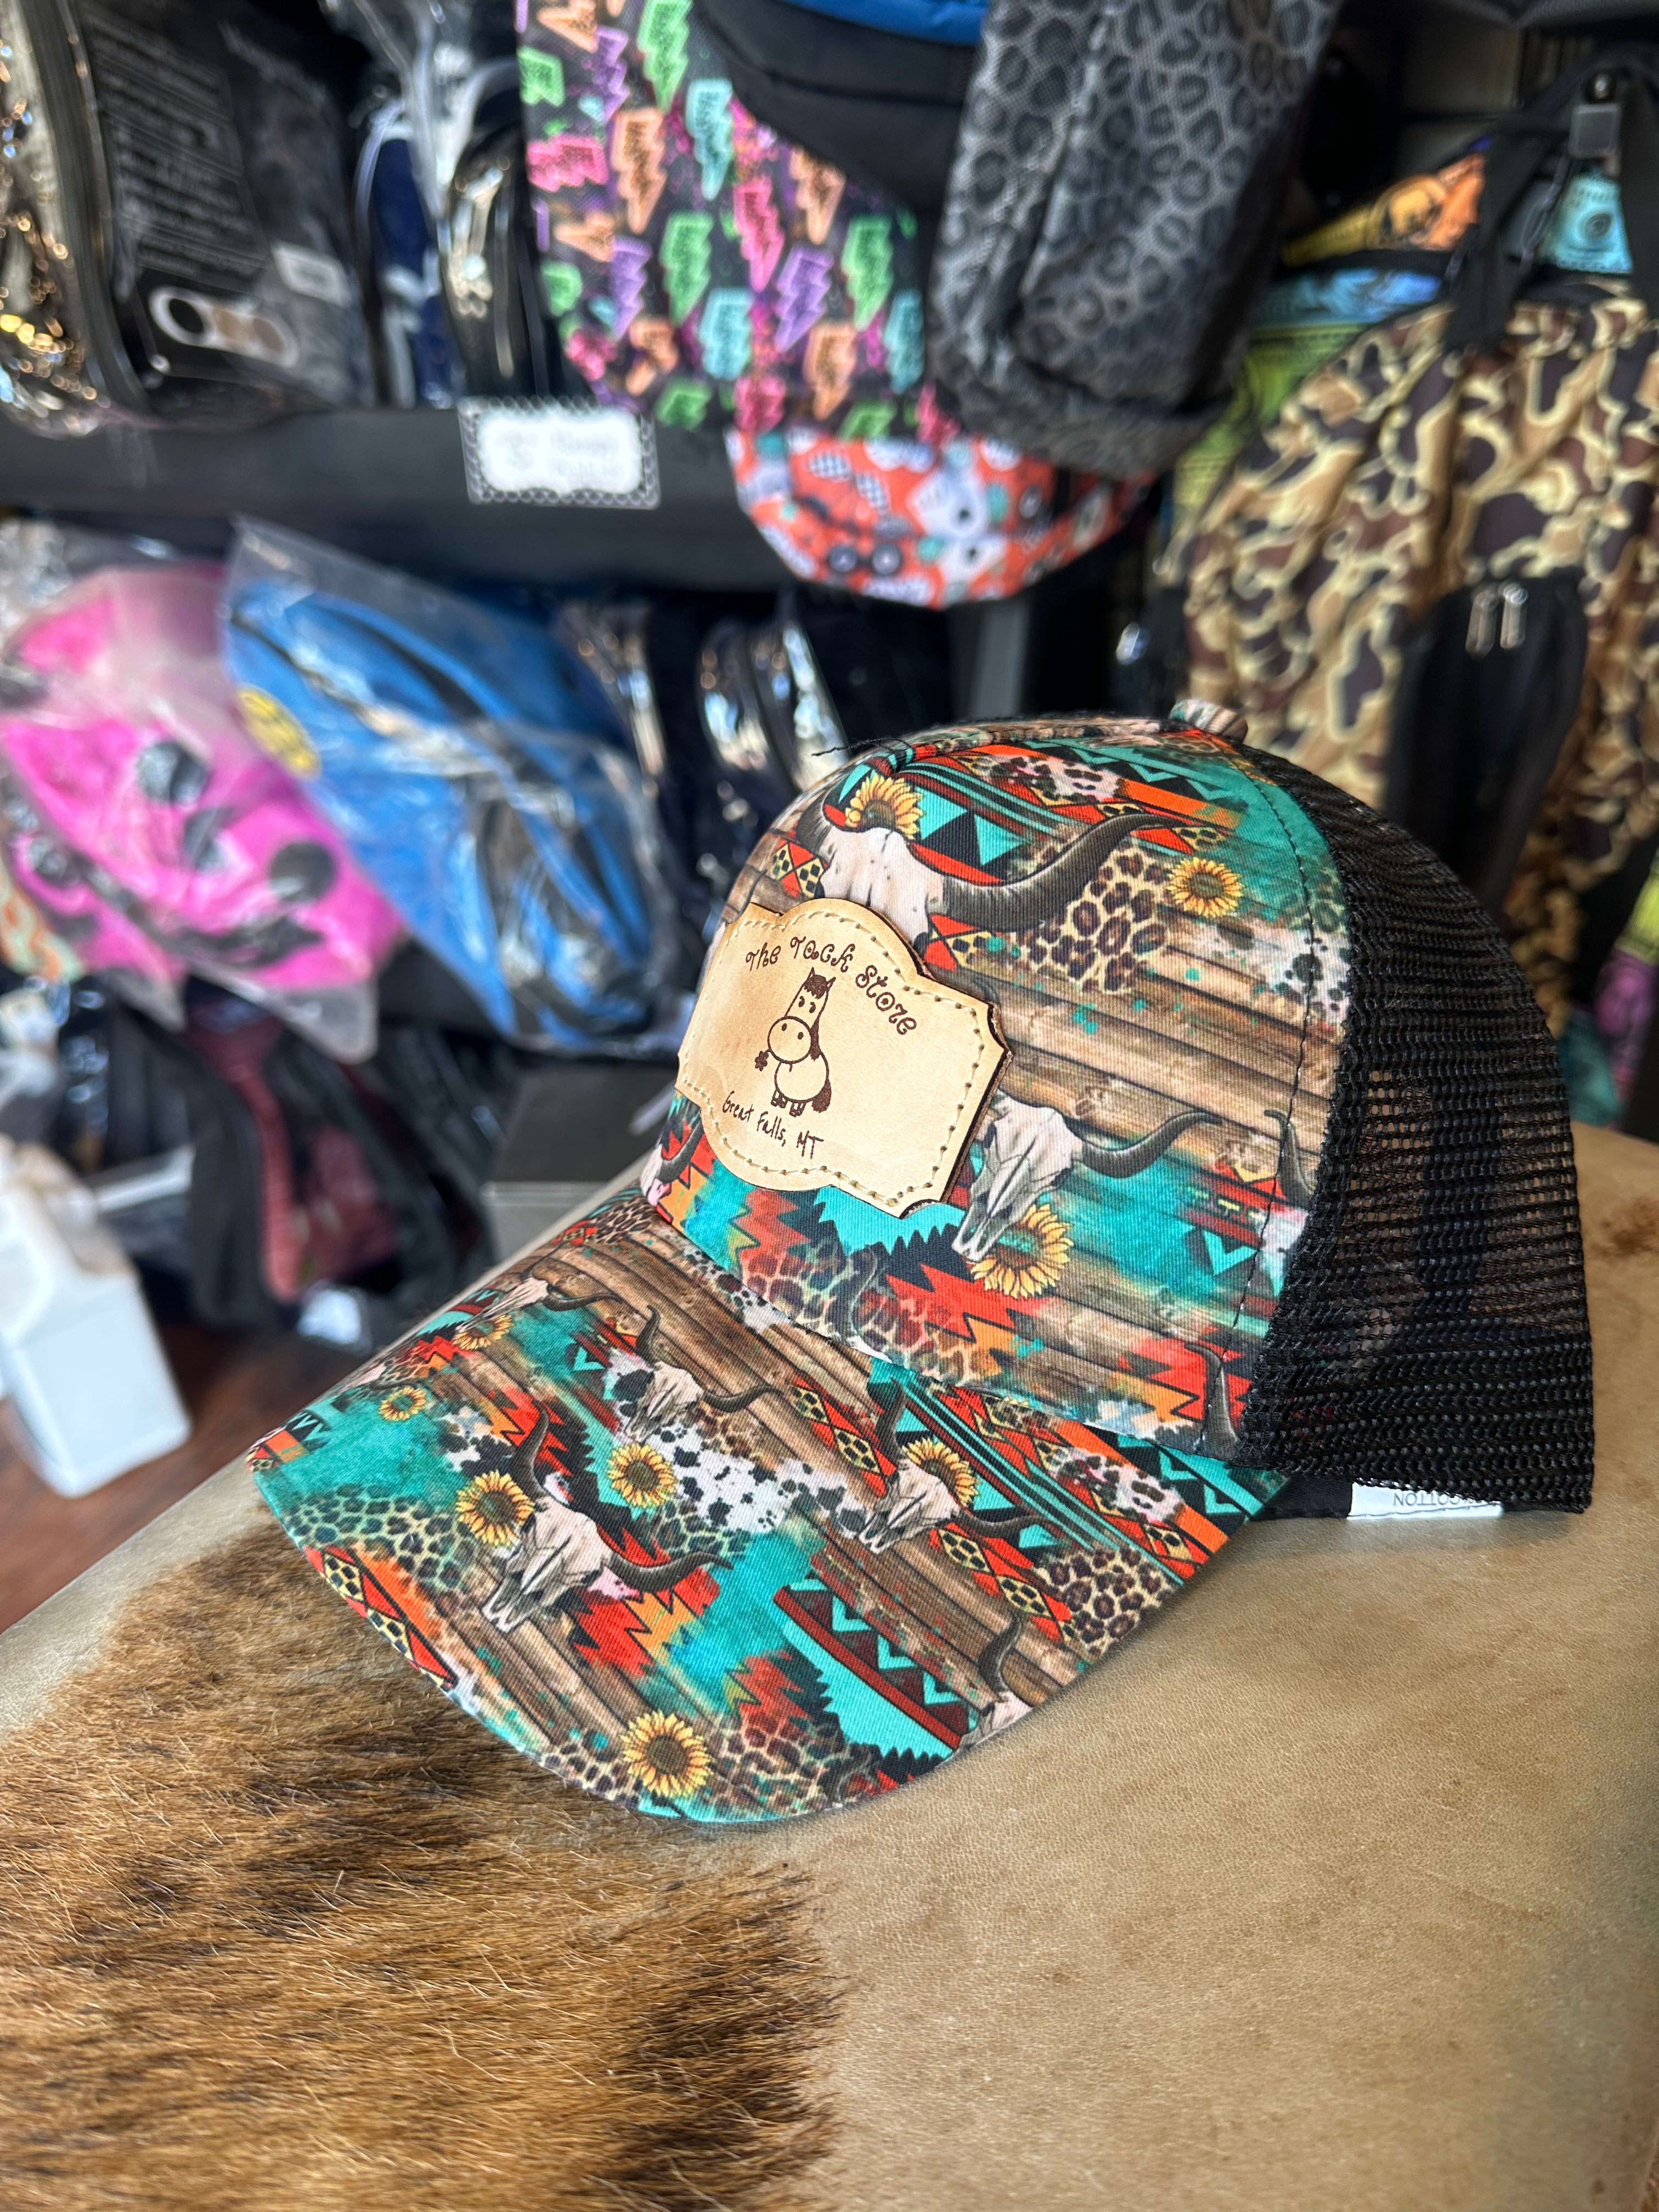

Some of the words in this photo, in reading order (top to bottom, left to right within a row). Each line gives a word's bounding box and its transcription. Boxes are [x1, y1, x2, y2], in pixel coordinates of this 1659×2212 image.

[745, 942, 782, 972] The
[789, 935, 856, 973] Tack
[855, 964, 917, 1036] Store
[722, 1090, 755, 1122] Great
[756, 1110, 787, 1147] Falls,
[796, 1130, 825, 1160] MT
[1393, 1492, 1460, 1506] COTTON
